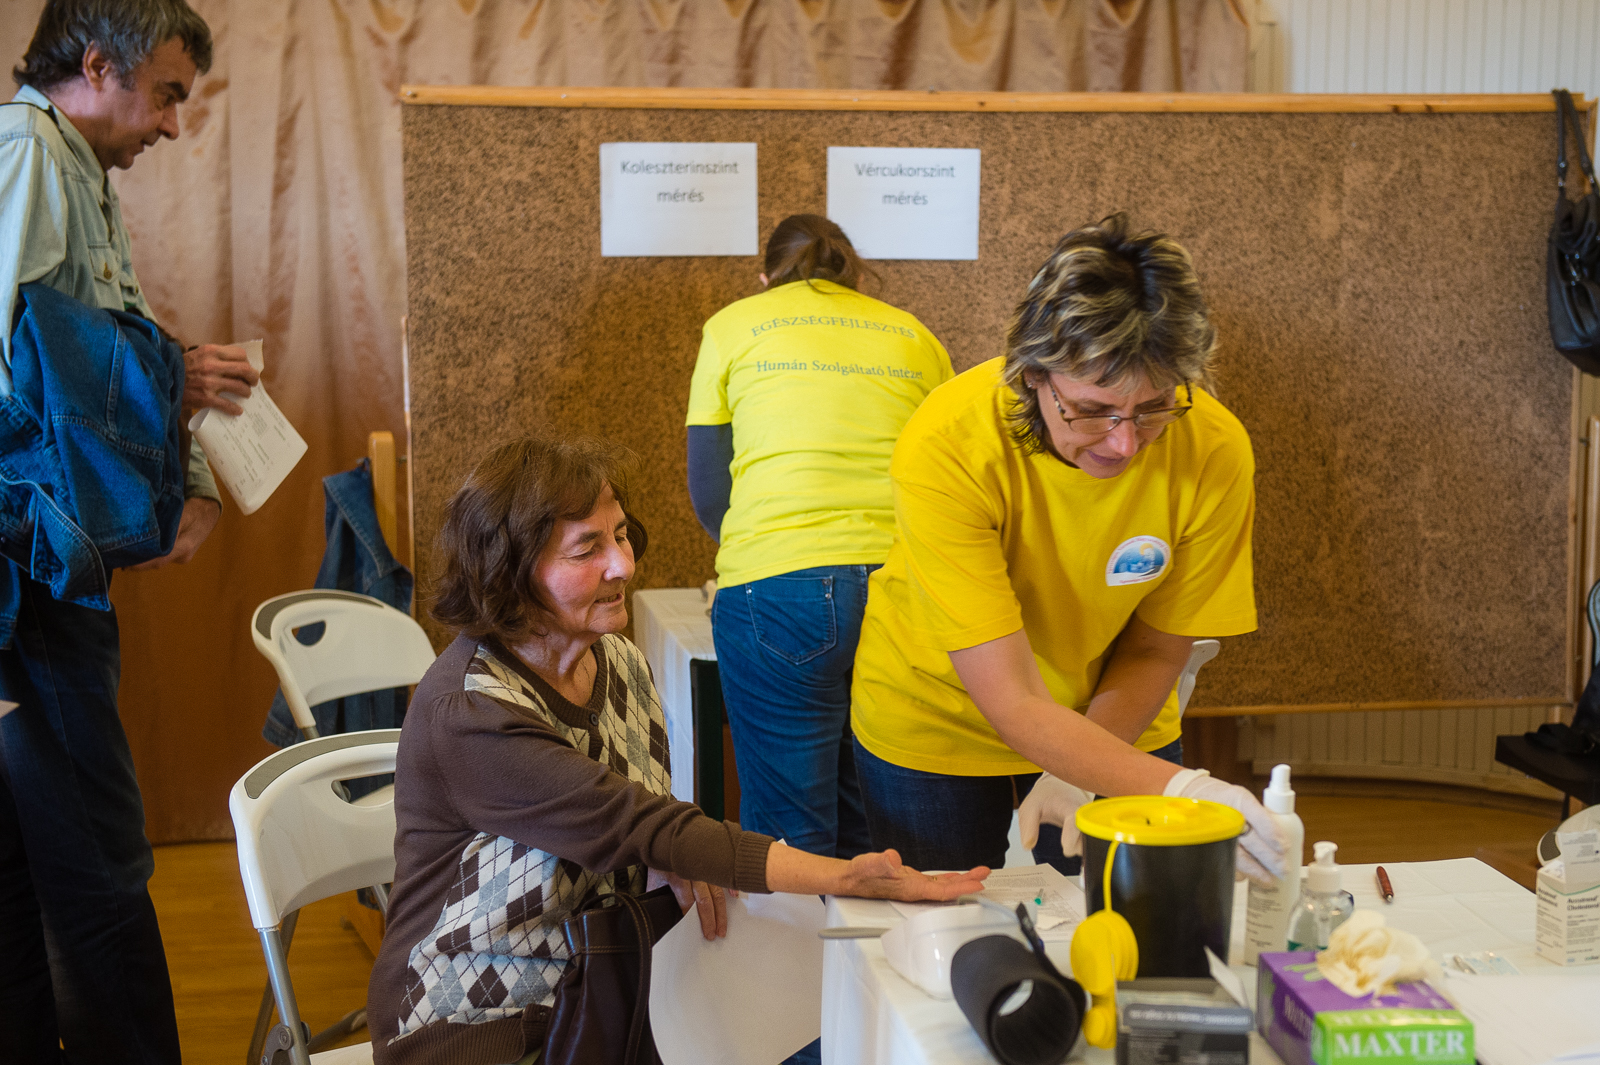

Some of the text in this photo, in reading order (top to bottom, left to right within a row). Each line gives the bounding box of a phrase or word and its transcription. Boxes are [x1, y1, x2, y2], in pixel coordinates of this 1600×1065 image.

[620, 160, 739, 174] Koleszterinszint
[854, 163, 956, 178] Vércukorszint
[657, 189, 705, 203] mérés
[882, 191, 929, 205] mérés
[751, 315, 916, 339] EGÉSZSÉGFEJLESZTÉS
[756, 359, 924, 380] Humán Szolgáltató Intézet
[1334, 1030, 1466, 1058] MAXTER
